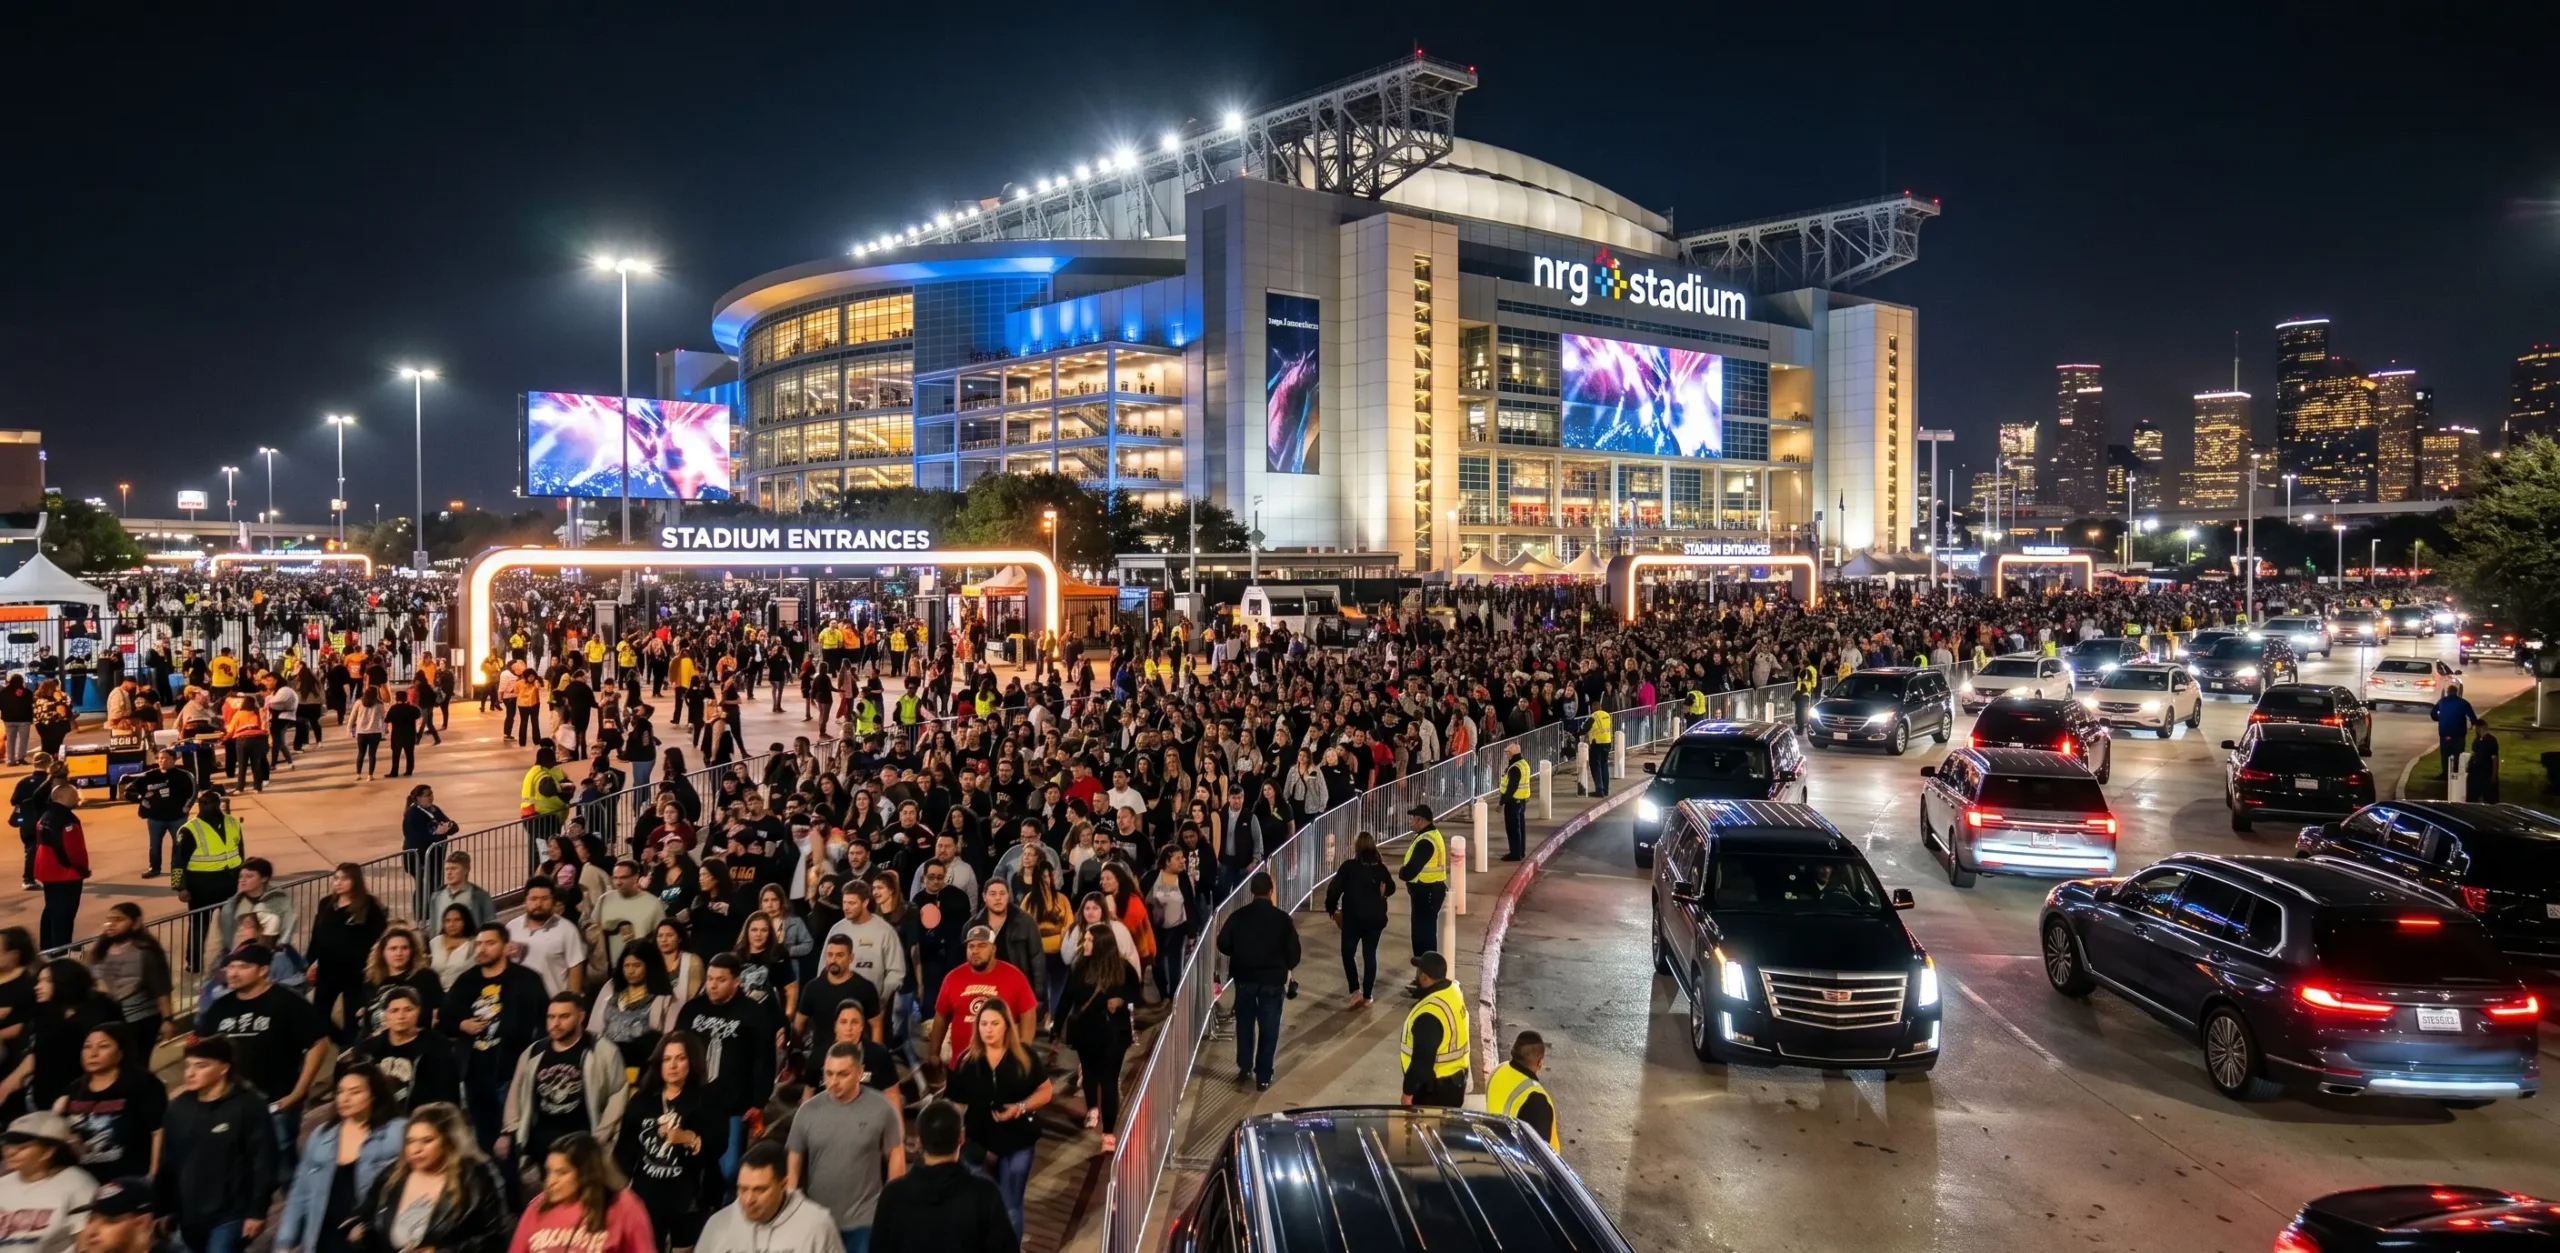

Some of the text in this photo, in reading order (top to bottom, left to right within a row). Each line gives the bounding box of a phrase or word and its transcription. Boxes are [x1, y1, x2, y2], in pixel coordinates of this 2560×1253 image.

[1533, 255, 1746, 321] nrg stadium
[661, 526, 931, 550] STADIUM ENTRANCES
[1683, 543, 1770, 555] STADIUM ENTRANCES
